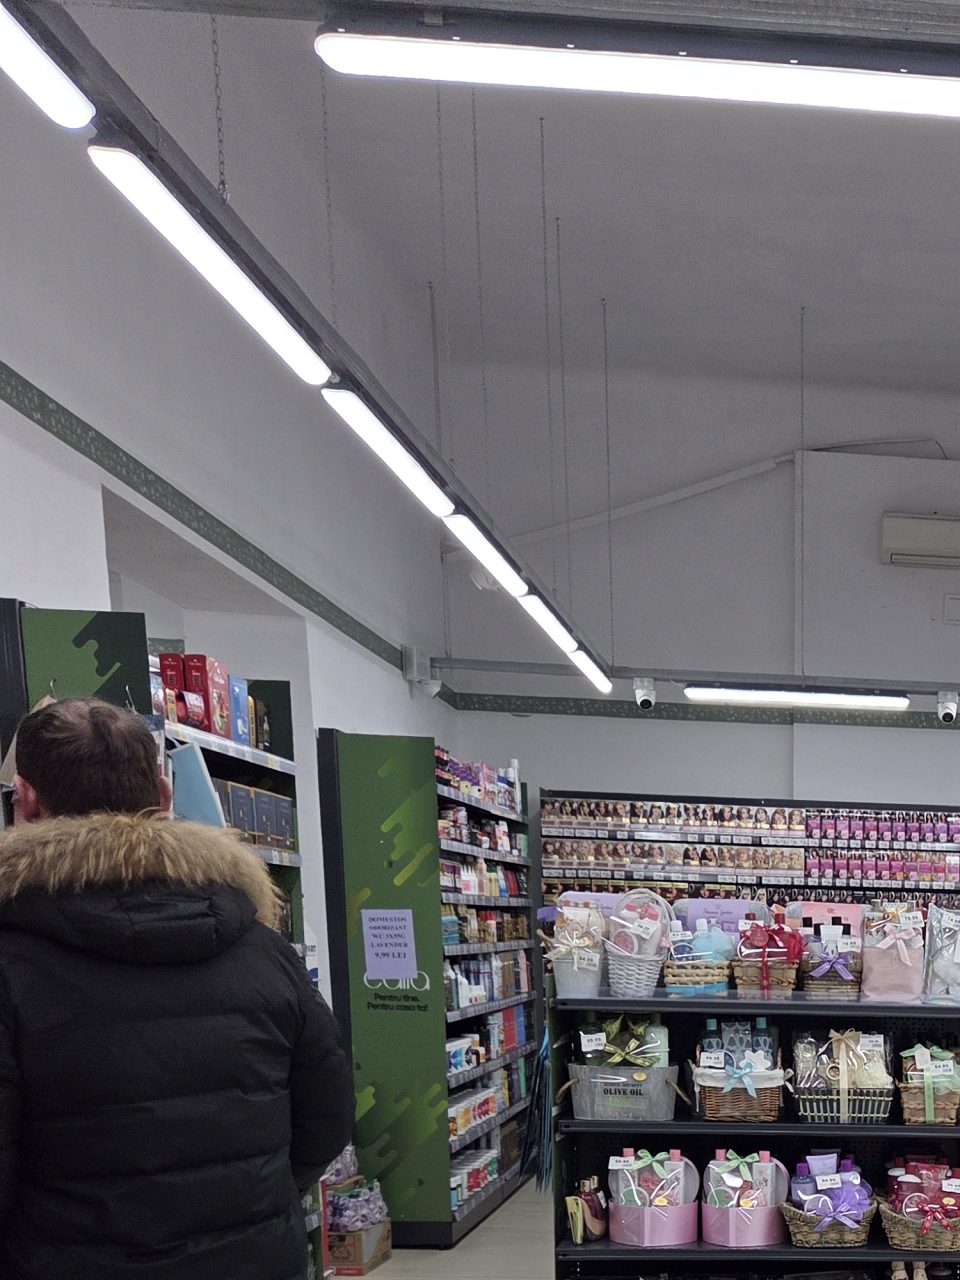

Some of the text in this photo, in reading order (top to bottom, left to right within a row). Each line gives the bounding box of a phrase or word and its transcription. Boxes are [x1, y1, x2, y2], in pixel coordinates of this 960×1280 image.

[374, 993, 401, 1002] Pentru
[367, 1002, 394, 1011] Pentru
[603, 1088, 645, 1096] OLIVE OIL
